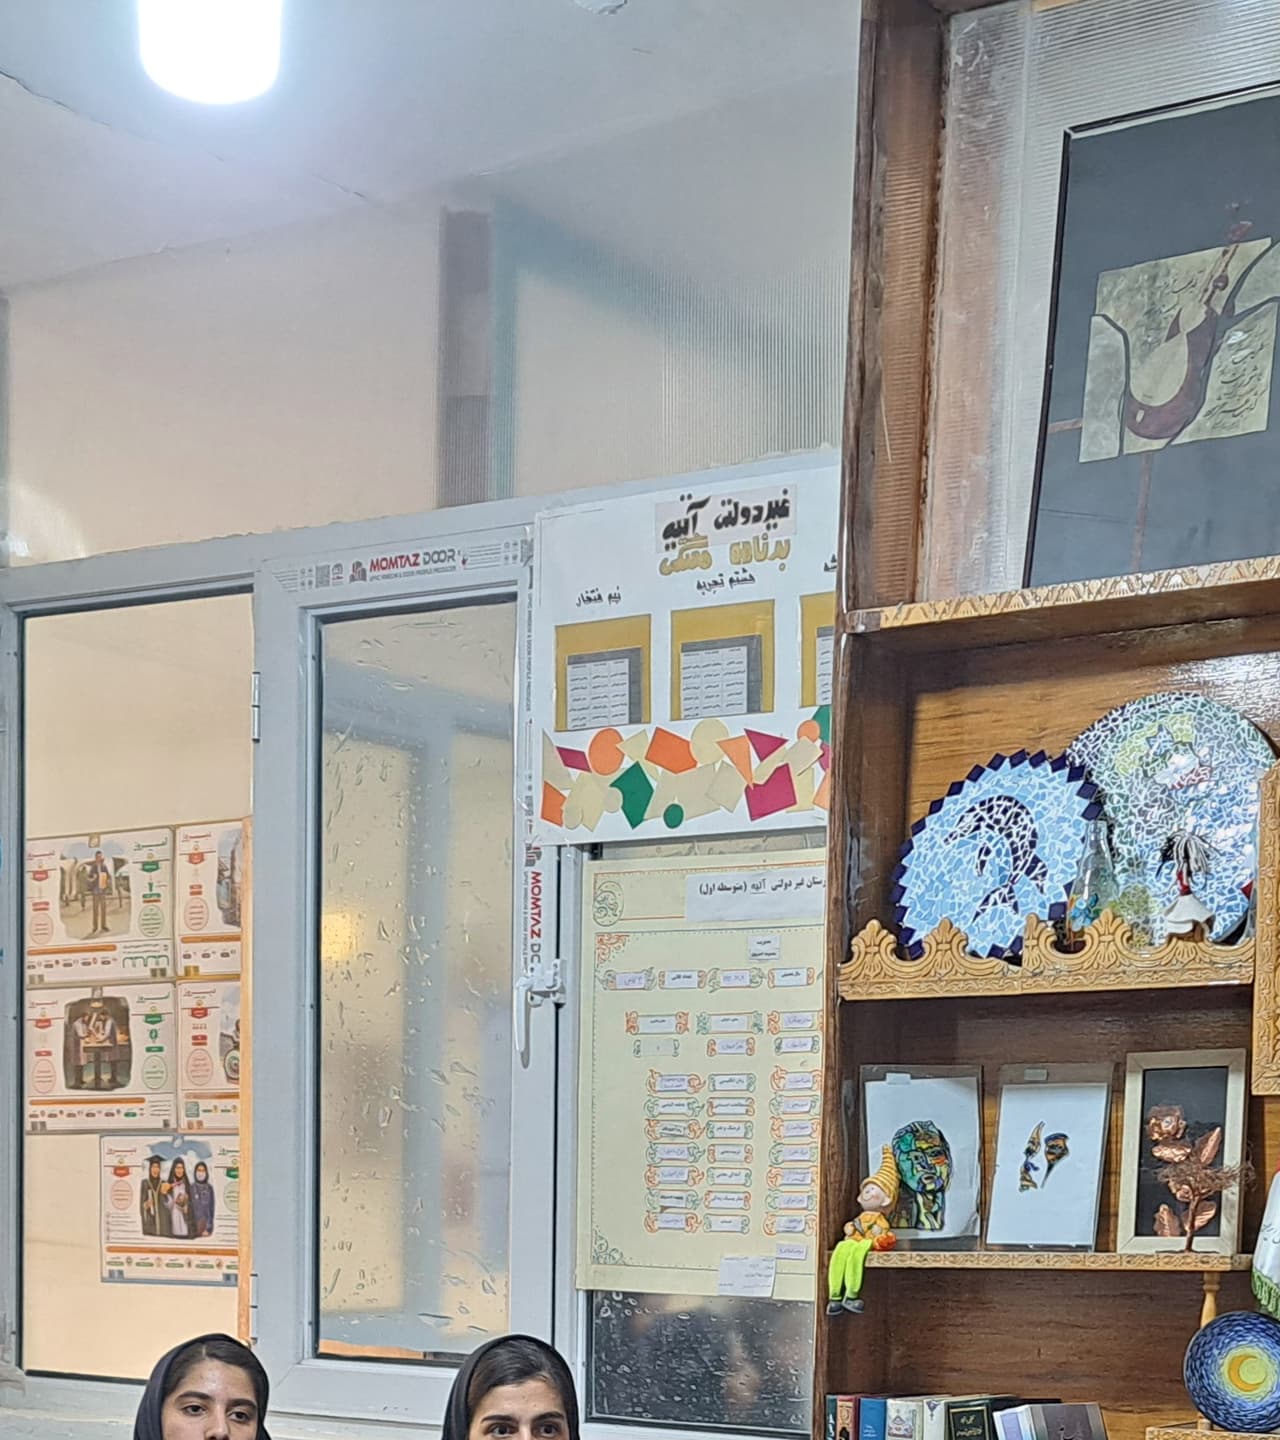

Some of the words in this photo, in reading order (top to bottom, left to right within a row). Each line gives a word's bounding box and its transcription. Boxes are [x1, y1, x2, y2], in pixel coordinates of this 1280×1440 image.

[369, 552, 420, 572] MOMTAZ
[423, 548, 456, 565] DOOR
[730, 533, 791, 571] برنامه
[696, 573, 725, 596] تجربه
[729, 567, 756, 589] هشتم
[530, 871, 542, 939] MOMTAZ
